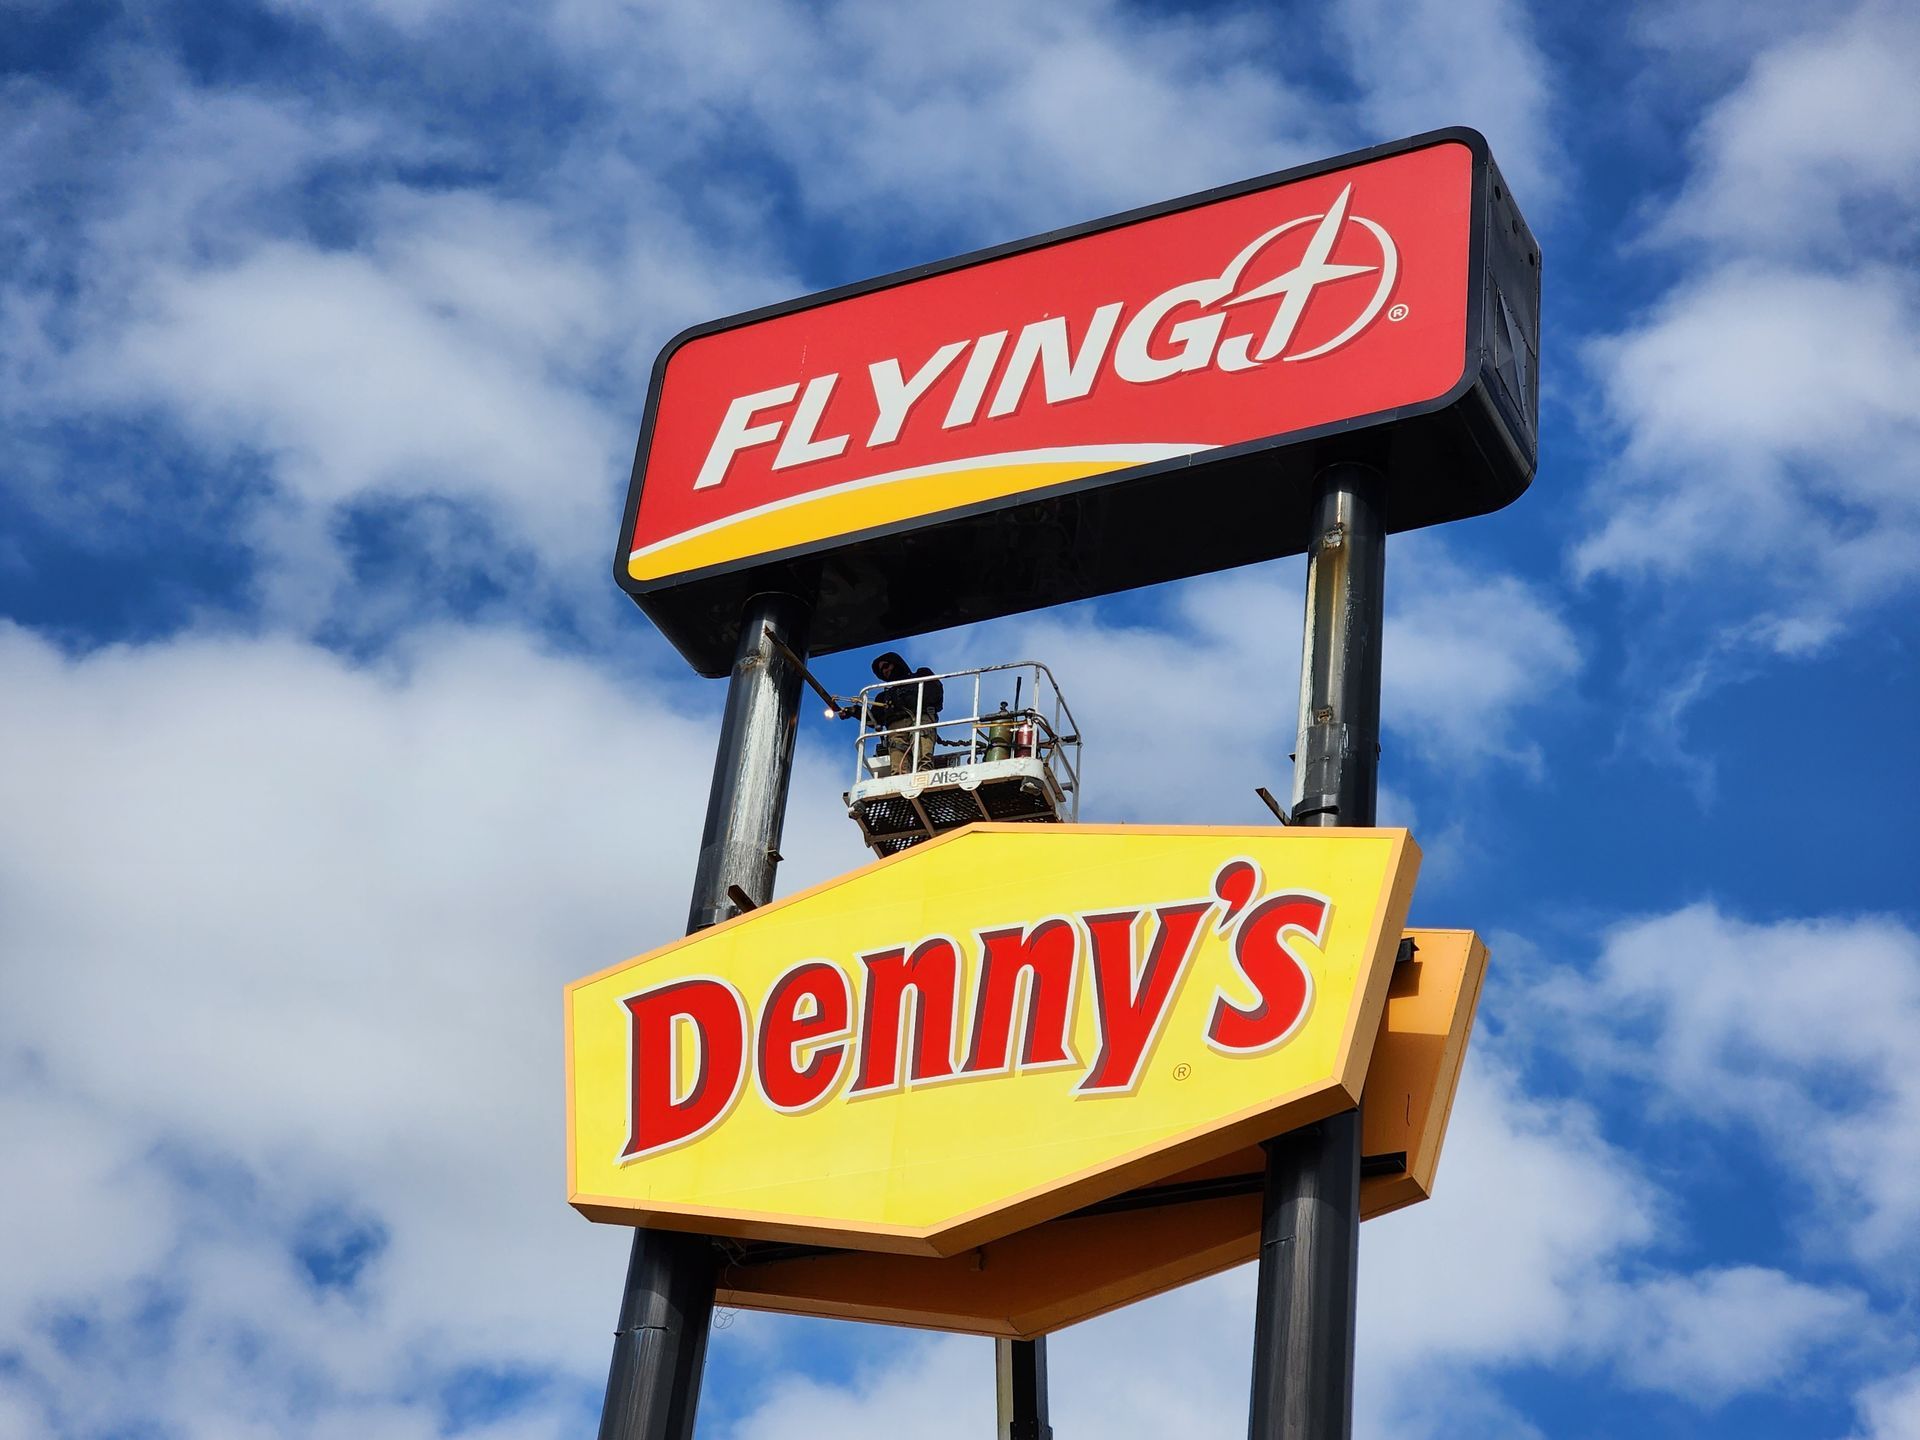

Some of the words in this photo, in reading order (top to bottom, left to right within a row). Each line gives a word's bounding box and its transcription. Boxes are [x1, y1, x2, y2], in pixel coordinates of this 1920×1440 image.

[693, 277, 1230, 491] FLYING
[930, 770, 968, 785] Altec
[615, 857, 1331, 1164] Denny's
